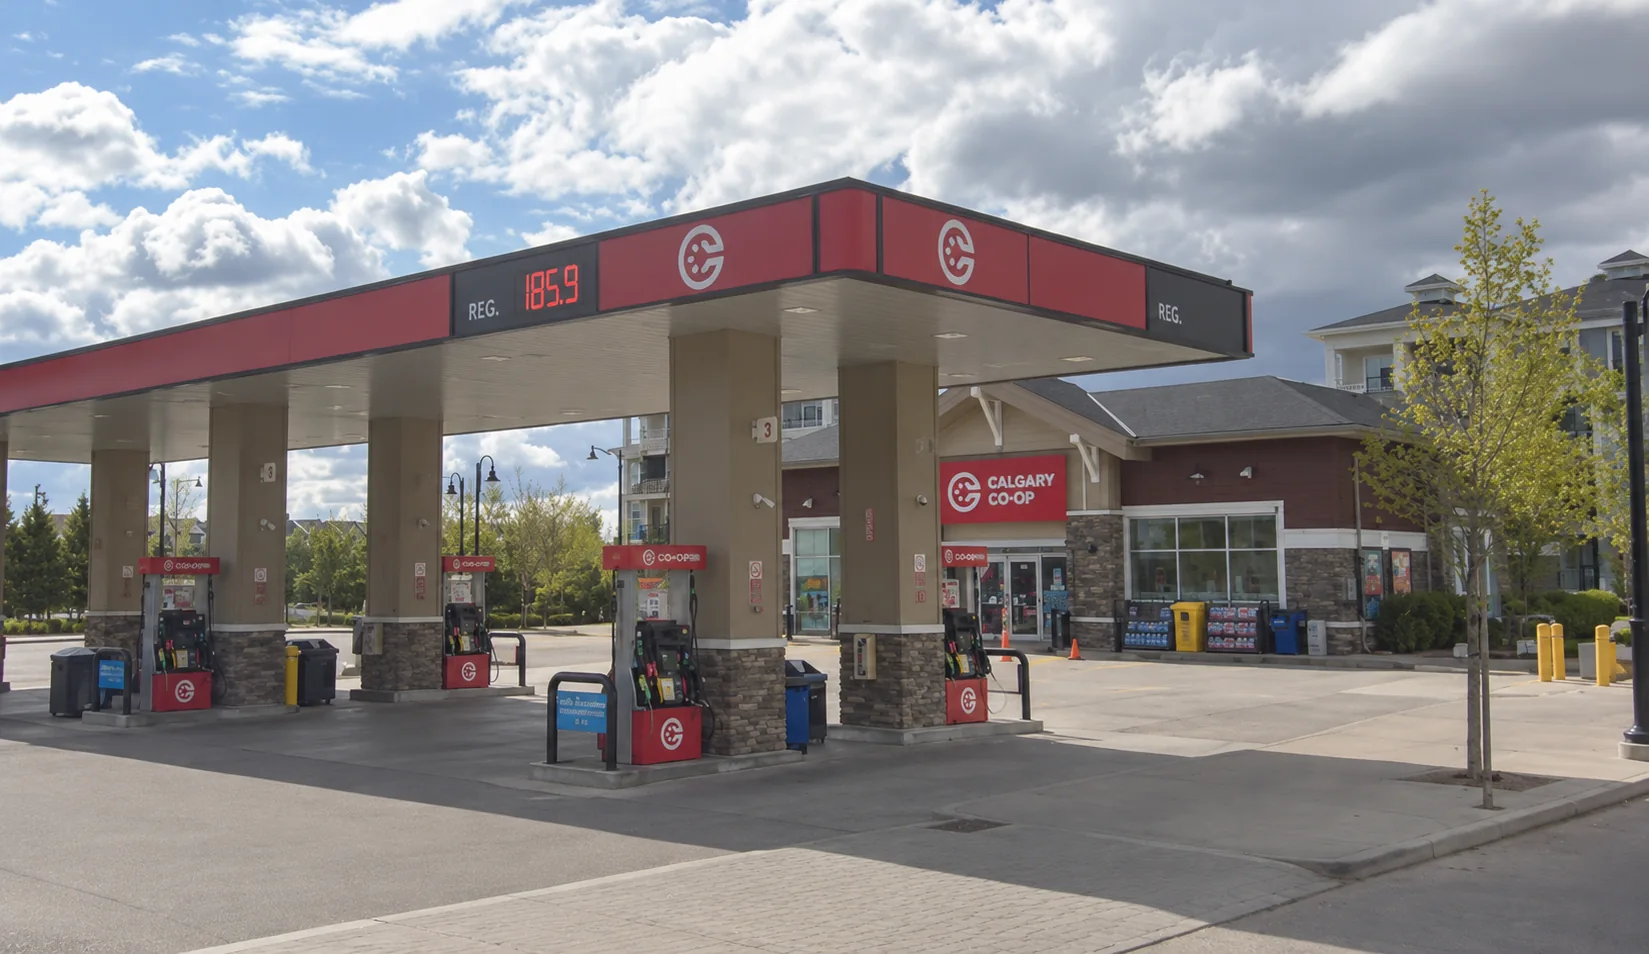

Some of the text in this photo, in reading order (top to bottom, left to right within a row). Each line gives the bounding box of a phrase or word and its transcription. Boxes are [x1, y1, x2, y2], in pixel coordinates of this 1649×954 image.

[469, 264, 578, 320] REG. 185.9
[1158, 302, 1182, 325] REG.
[764, 421, 771, 438] 3
[987, 473, 1055, 489] CALGARY
